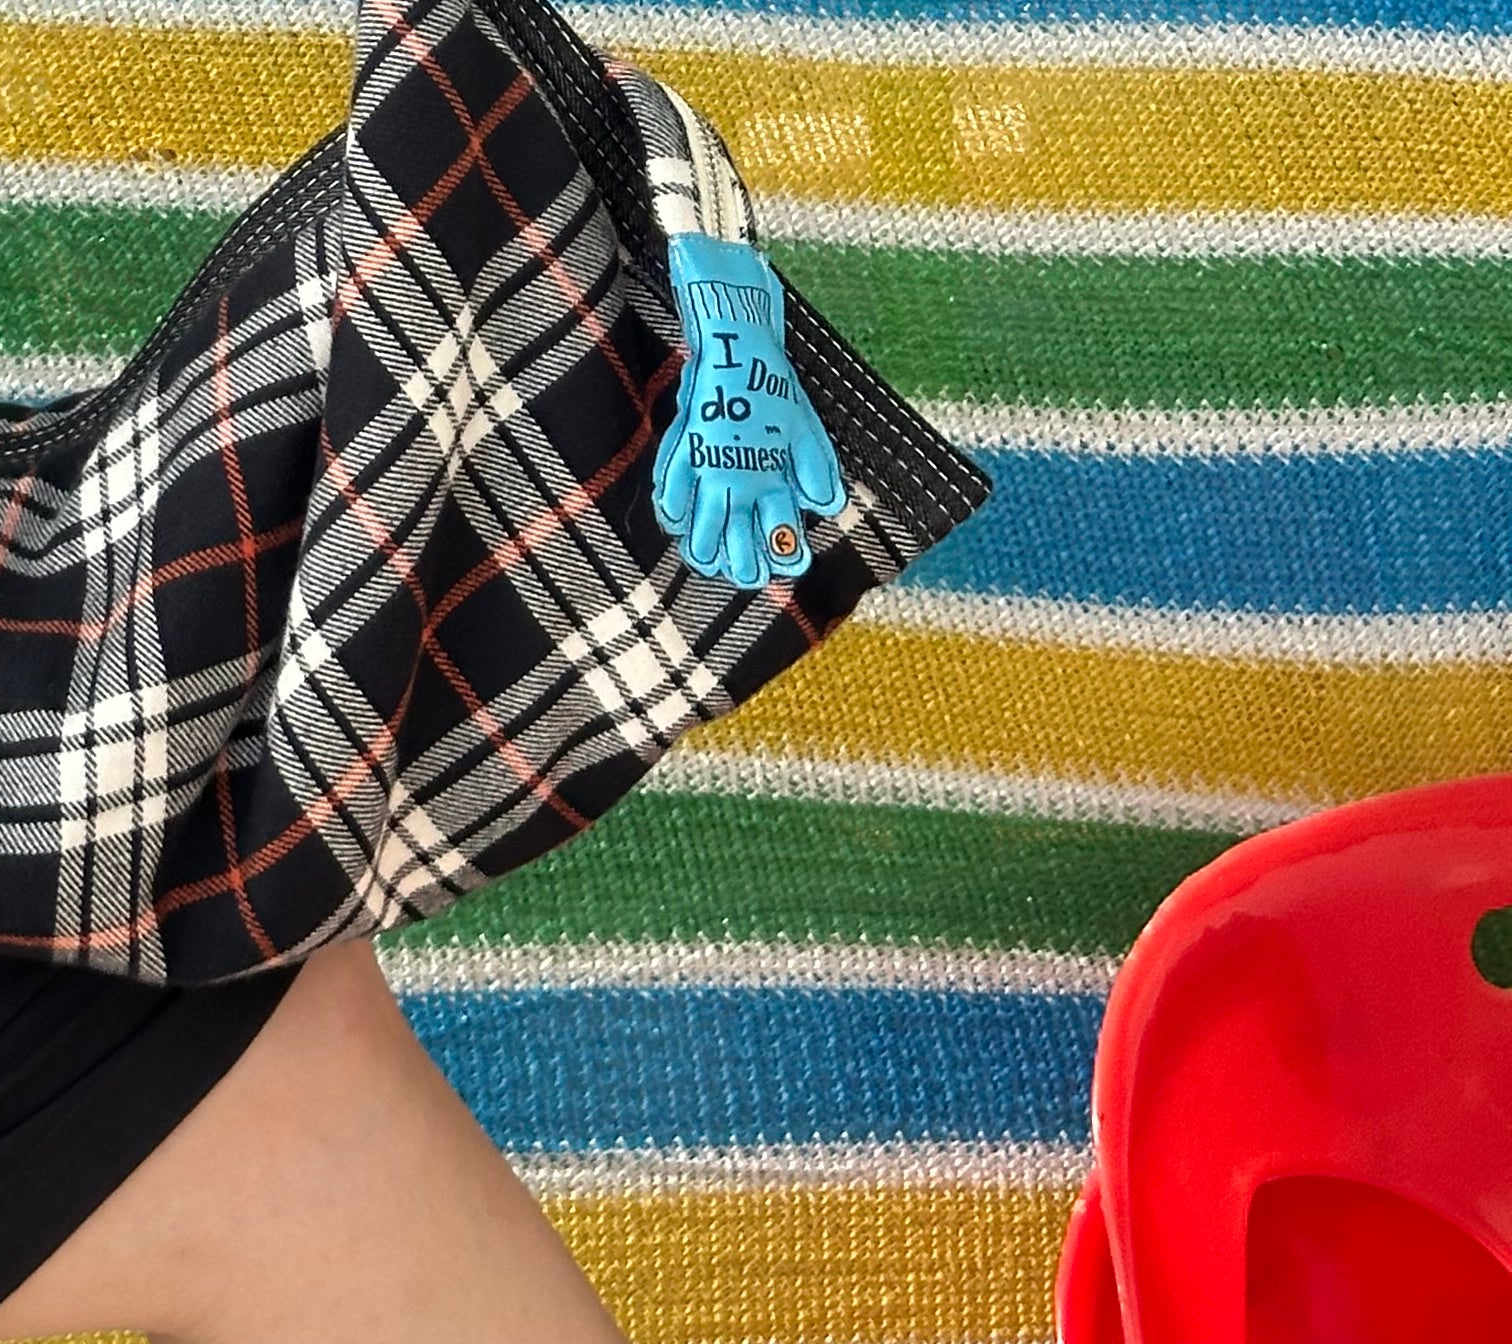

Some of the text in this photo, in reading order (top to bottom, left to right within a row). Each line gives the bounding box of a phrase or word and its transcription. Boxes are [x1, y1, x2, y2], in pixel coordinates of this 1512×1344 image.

[712, 332, 743, 369] I
[700, 385, 752, 422] do
[689, 432, 787, 472] Business
